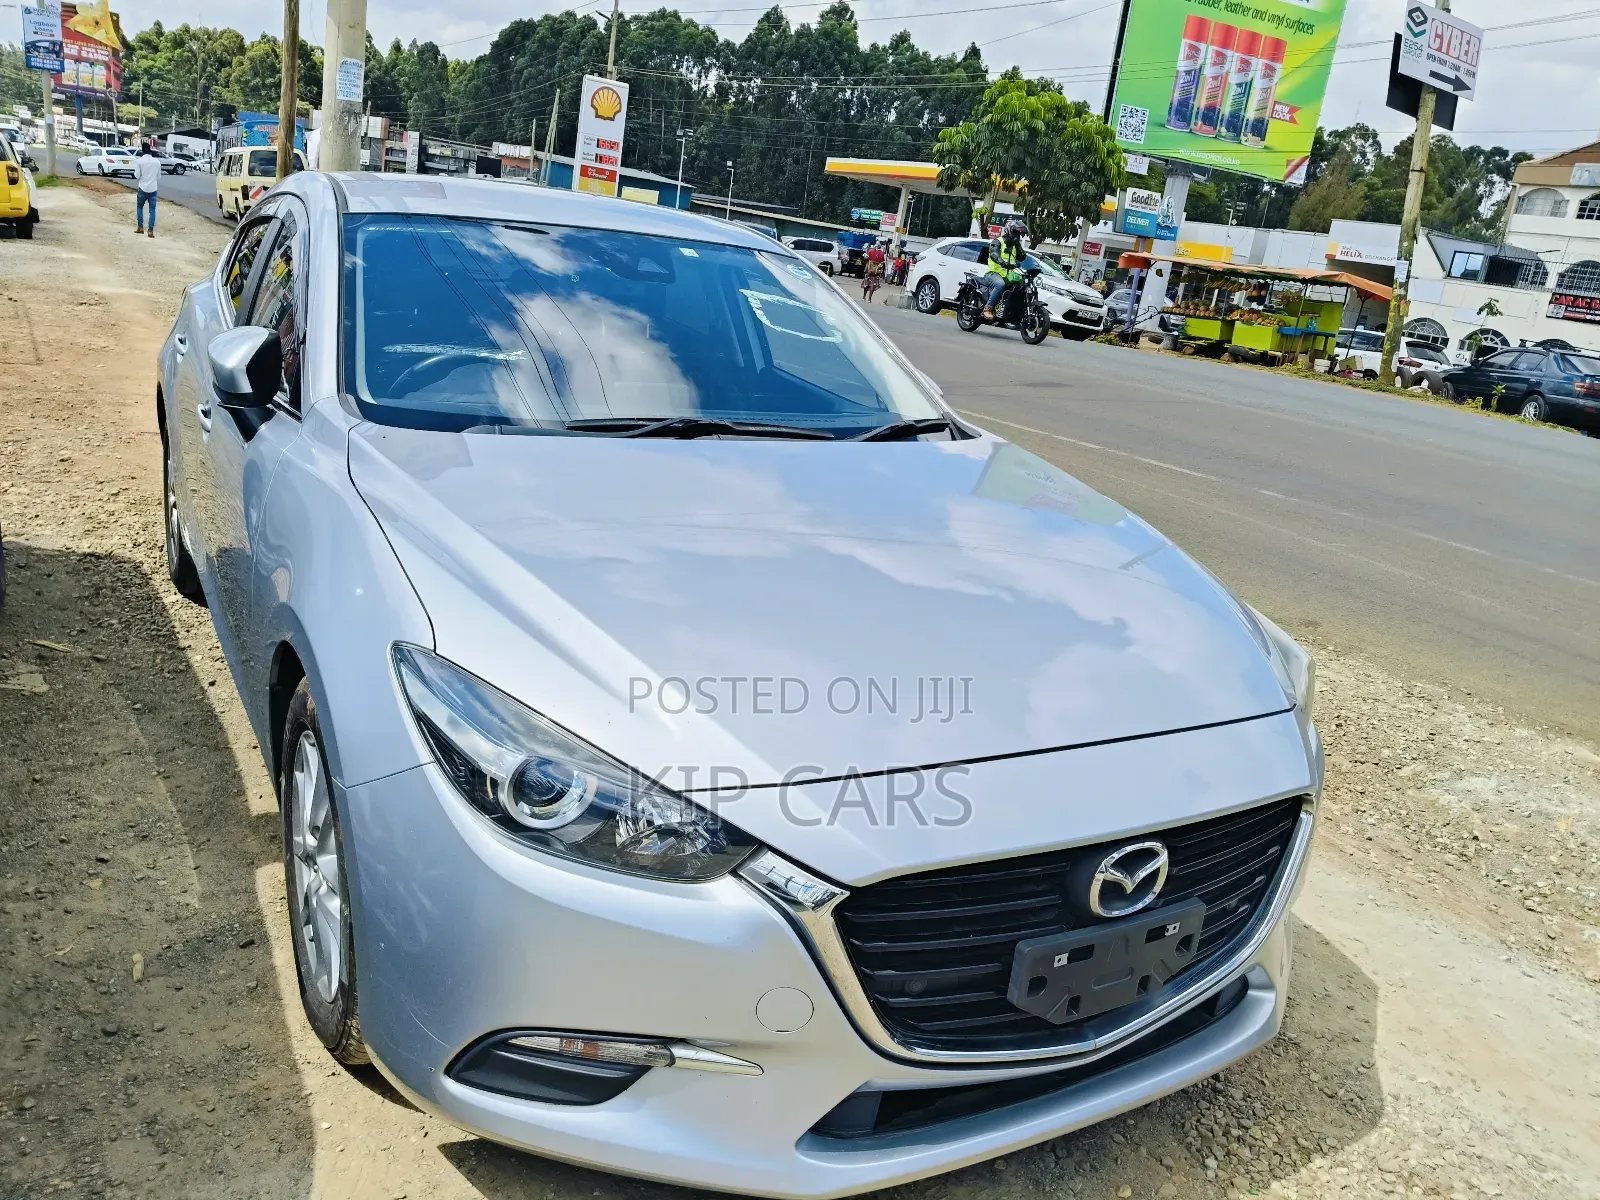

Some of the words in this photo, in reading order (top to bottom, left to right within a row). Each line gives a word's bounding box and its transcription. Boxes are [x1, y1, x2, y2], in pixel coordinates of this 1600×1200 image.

[1224, 0, 1251, 17] leather
[1252, 9, 1268, 21] and
[1268, 12, 1285, 30] vinyl
[1285, 16, 1316, 35] surfaces
[1404, 38, 1423, 52] E254
[1429, 20, 1480, 67] CYBER
[1403, 48, 1422, 58] GROUP
[1274, 103, 1290, 114] NEW
[1272, 110, 1292, 121] LOOK
[1180, 148, 1240, 165] www.tropikal.co.ke
[1126, 216, 1149, 226] DELIVER
[1340, 249, 1364, 258] HELIX
[1552, 294, 1573, 306] CAR
[1574, 298, 1590, 308] AC
